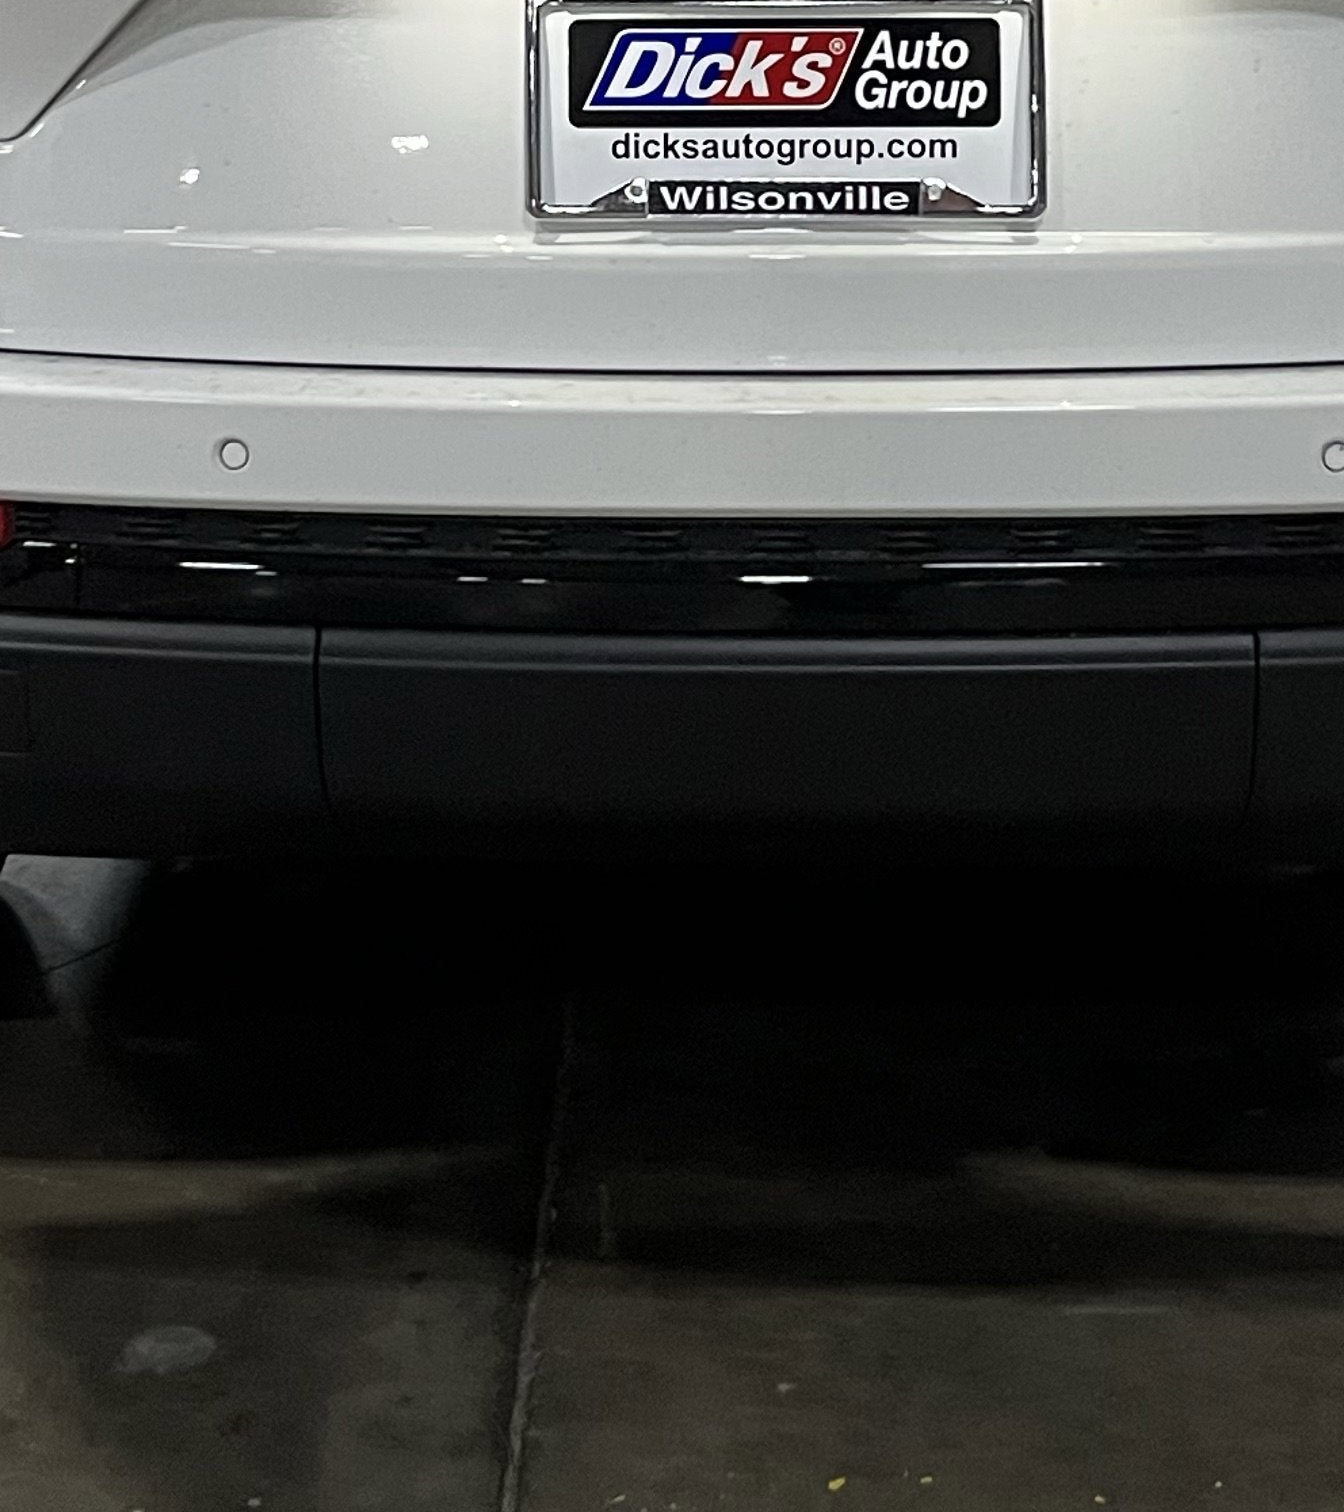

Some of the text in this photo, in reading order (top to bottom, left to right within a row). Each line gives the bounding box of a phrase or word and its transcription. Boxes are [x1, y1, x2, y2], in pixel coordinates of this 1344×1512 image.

[861, 29, 971, 71] Auto
[854, 72, 989, 119] Group
[610, 132, 959, 166] dicksautogroup.com
[659, 186, 910, 212] Wilsonville
